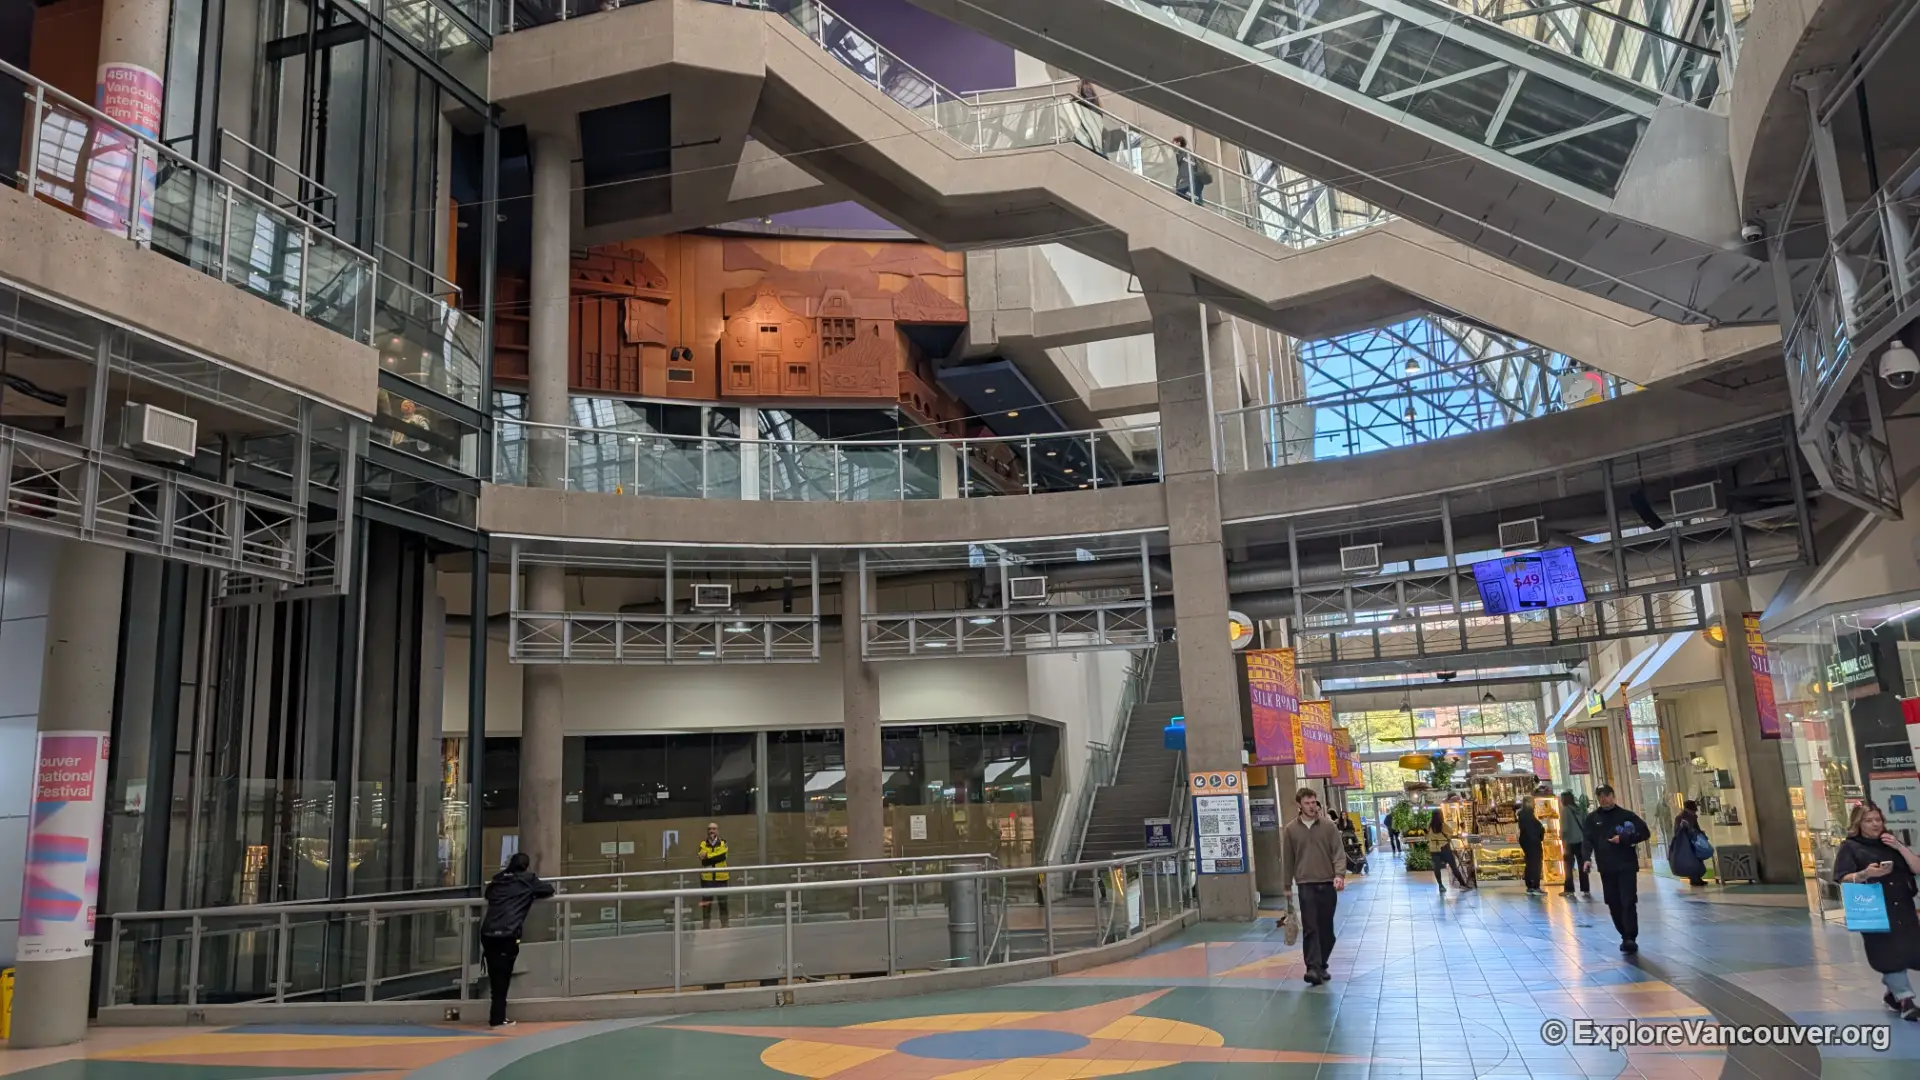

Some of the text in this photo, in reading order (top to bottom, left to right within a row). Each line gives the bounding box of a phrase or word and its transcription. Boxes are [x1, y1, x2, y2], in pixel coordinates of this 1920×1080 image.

[107, 70, 138, 82] 45th
[105, 106, 131, 118] Film
[1513, 574, 1540, 588] $49
[1253, 690, 1298, 712] SILK ROAD
[40, 757, 81, 767] ouver
[1886, 756, 1904, 765] PRIME
[1905, 755, 1913, 763] CE
[36, 785, 90, 798] Festival
